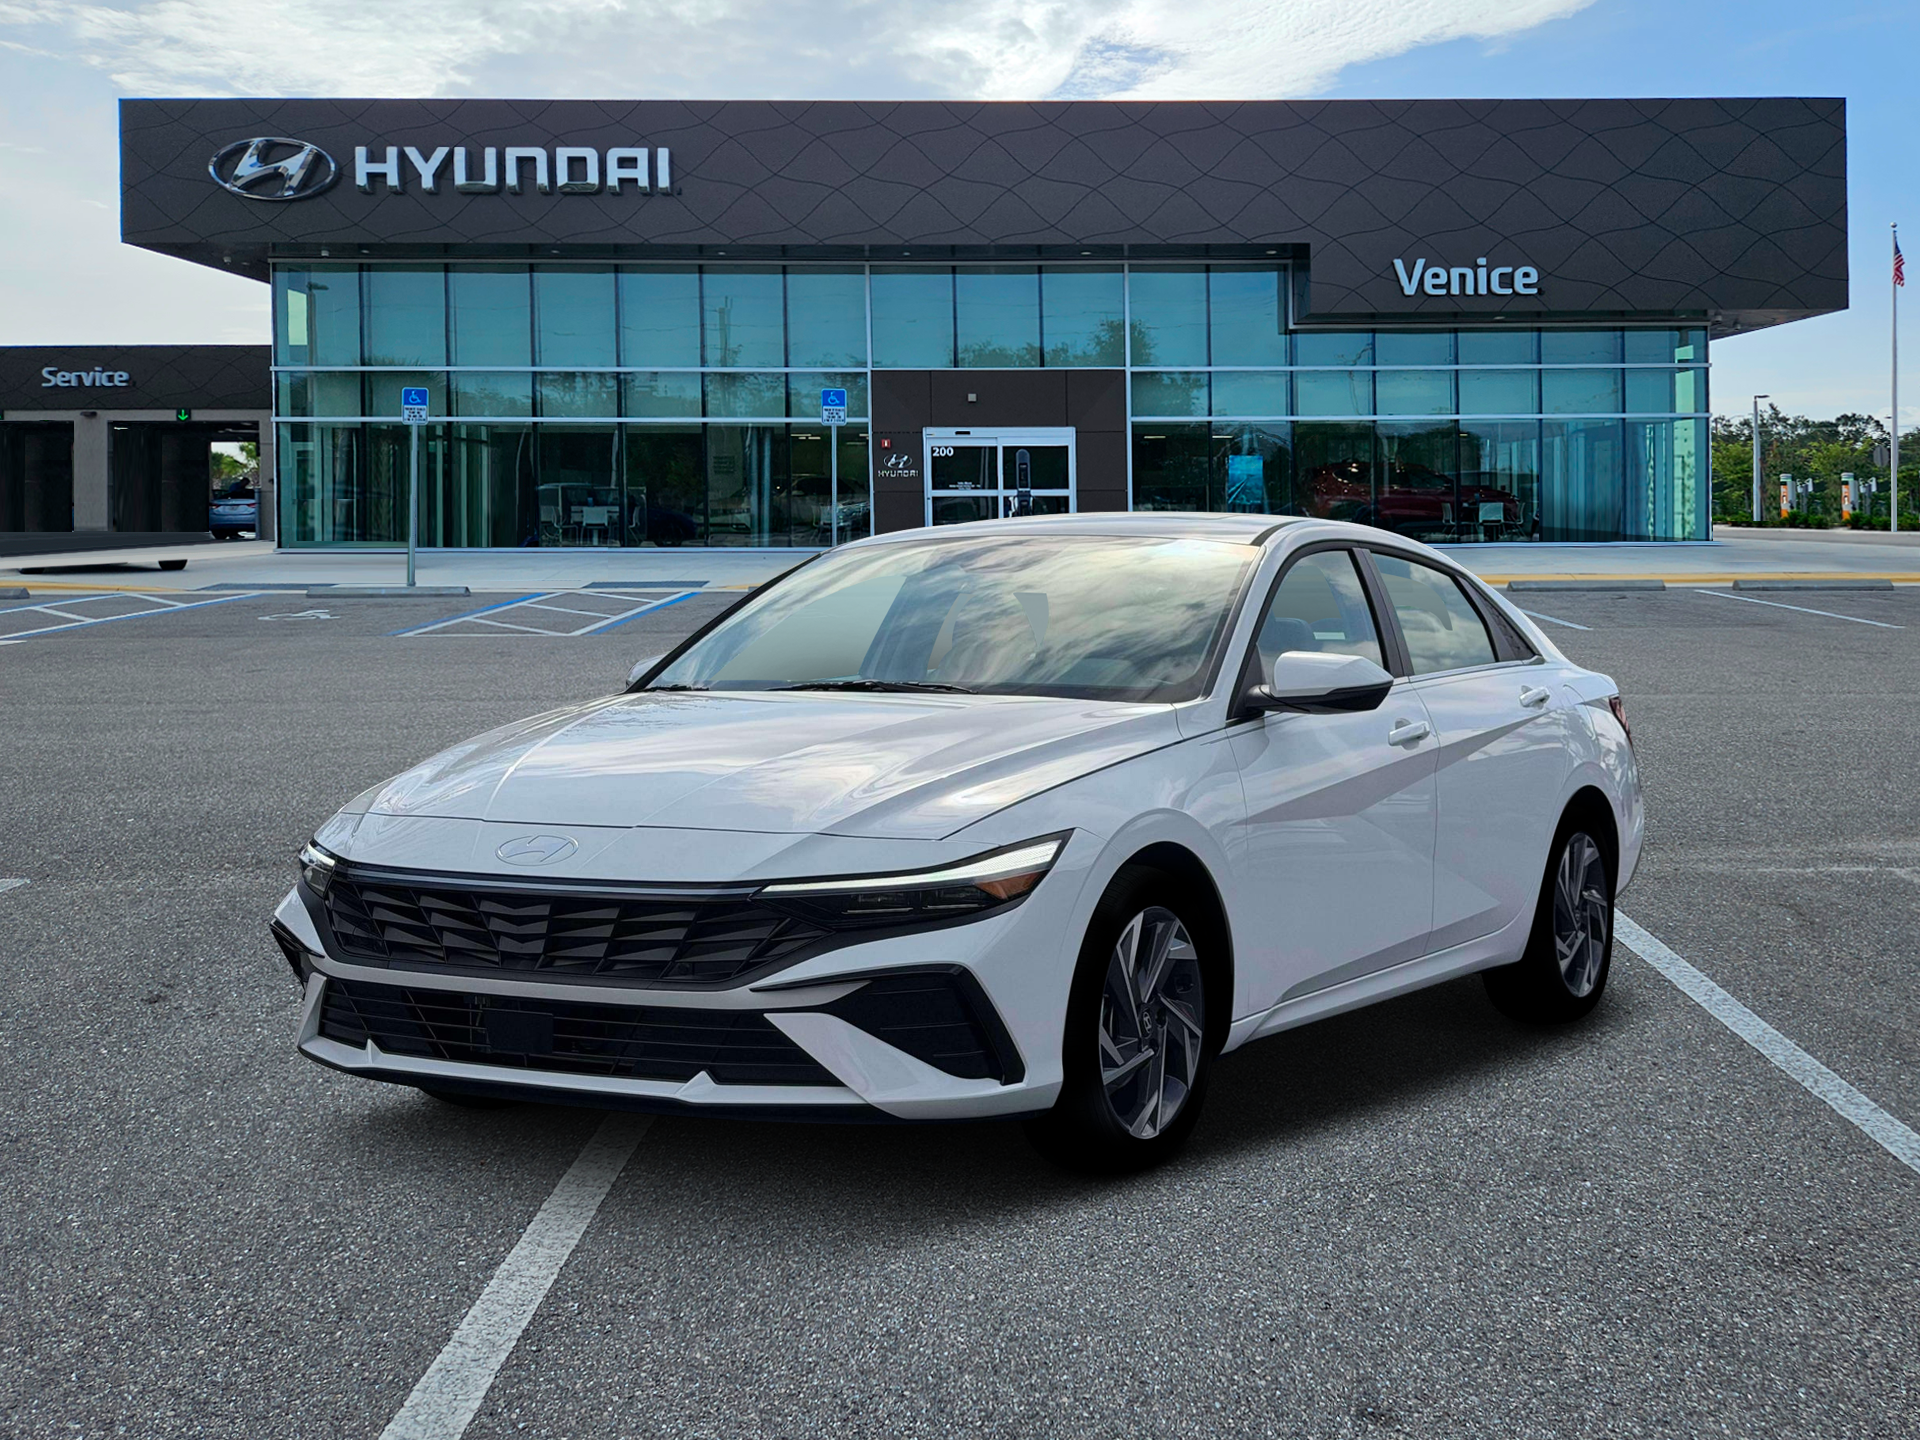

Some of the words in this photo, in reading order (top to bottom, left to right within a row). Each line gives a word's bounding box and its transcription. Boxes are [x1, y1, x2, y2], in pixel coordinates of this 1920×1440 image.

[354, 146, 672, 195] HYUNDAI
[1393, 257, 1539, 296] Venice
[41, 366, 130, 387] Service
[932, 446, 954, 457] 200
[877, 470, 919, 478] HYUNDAI
